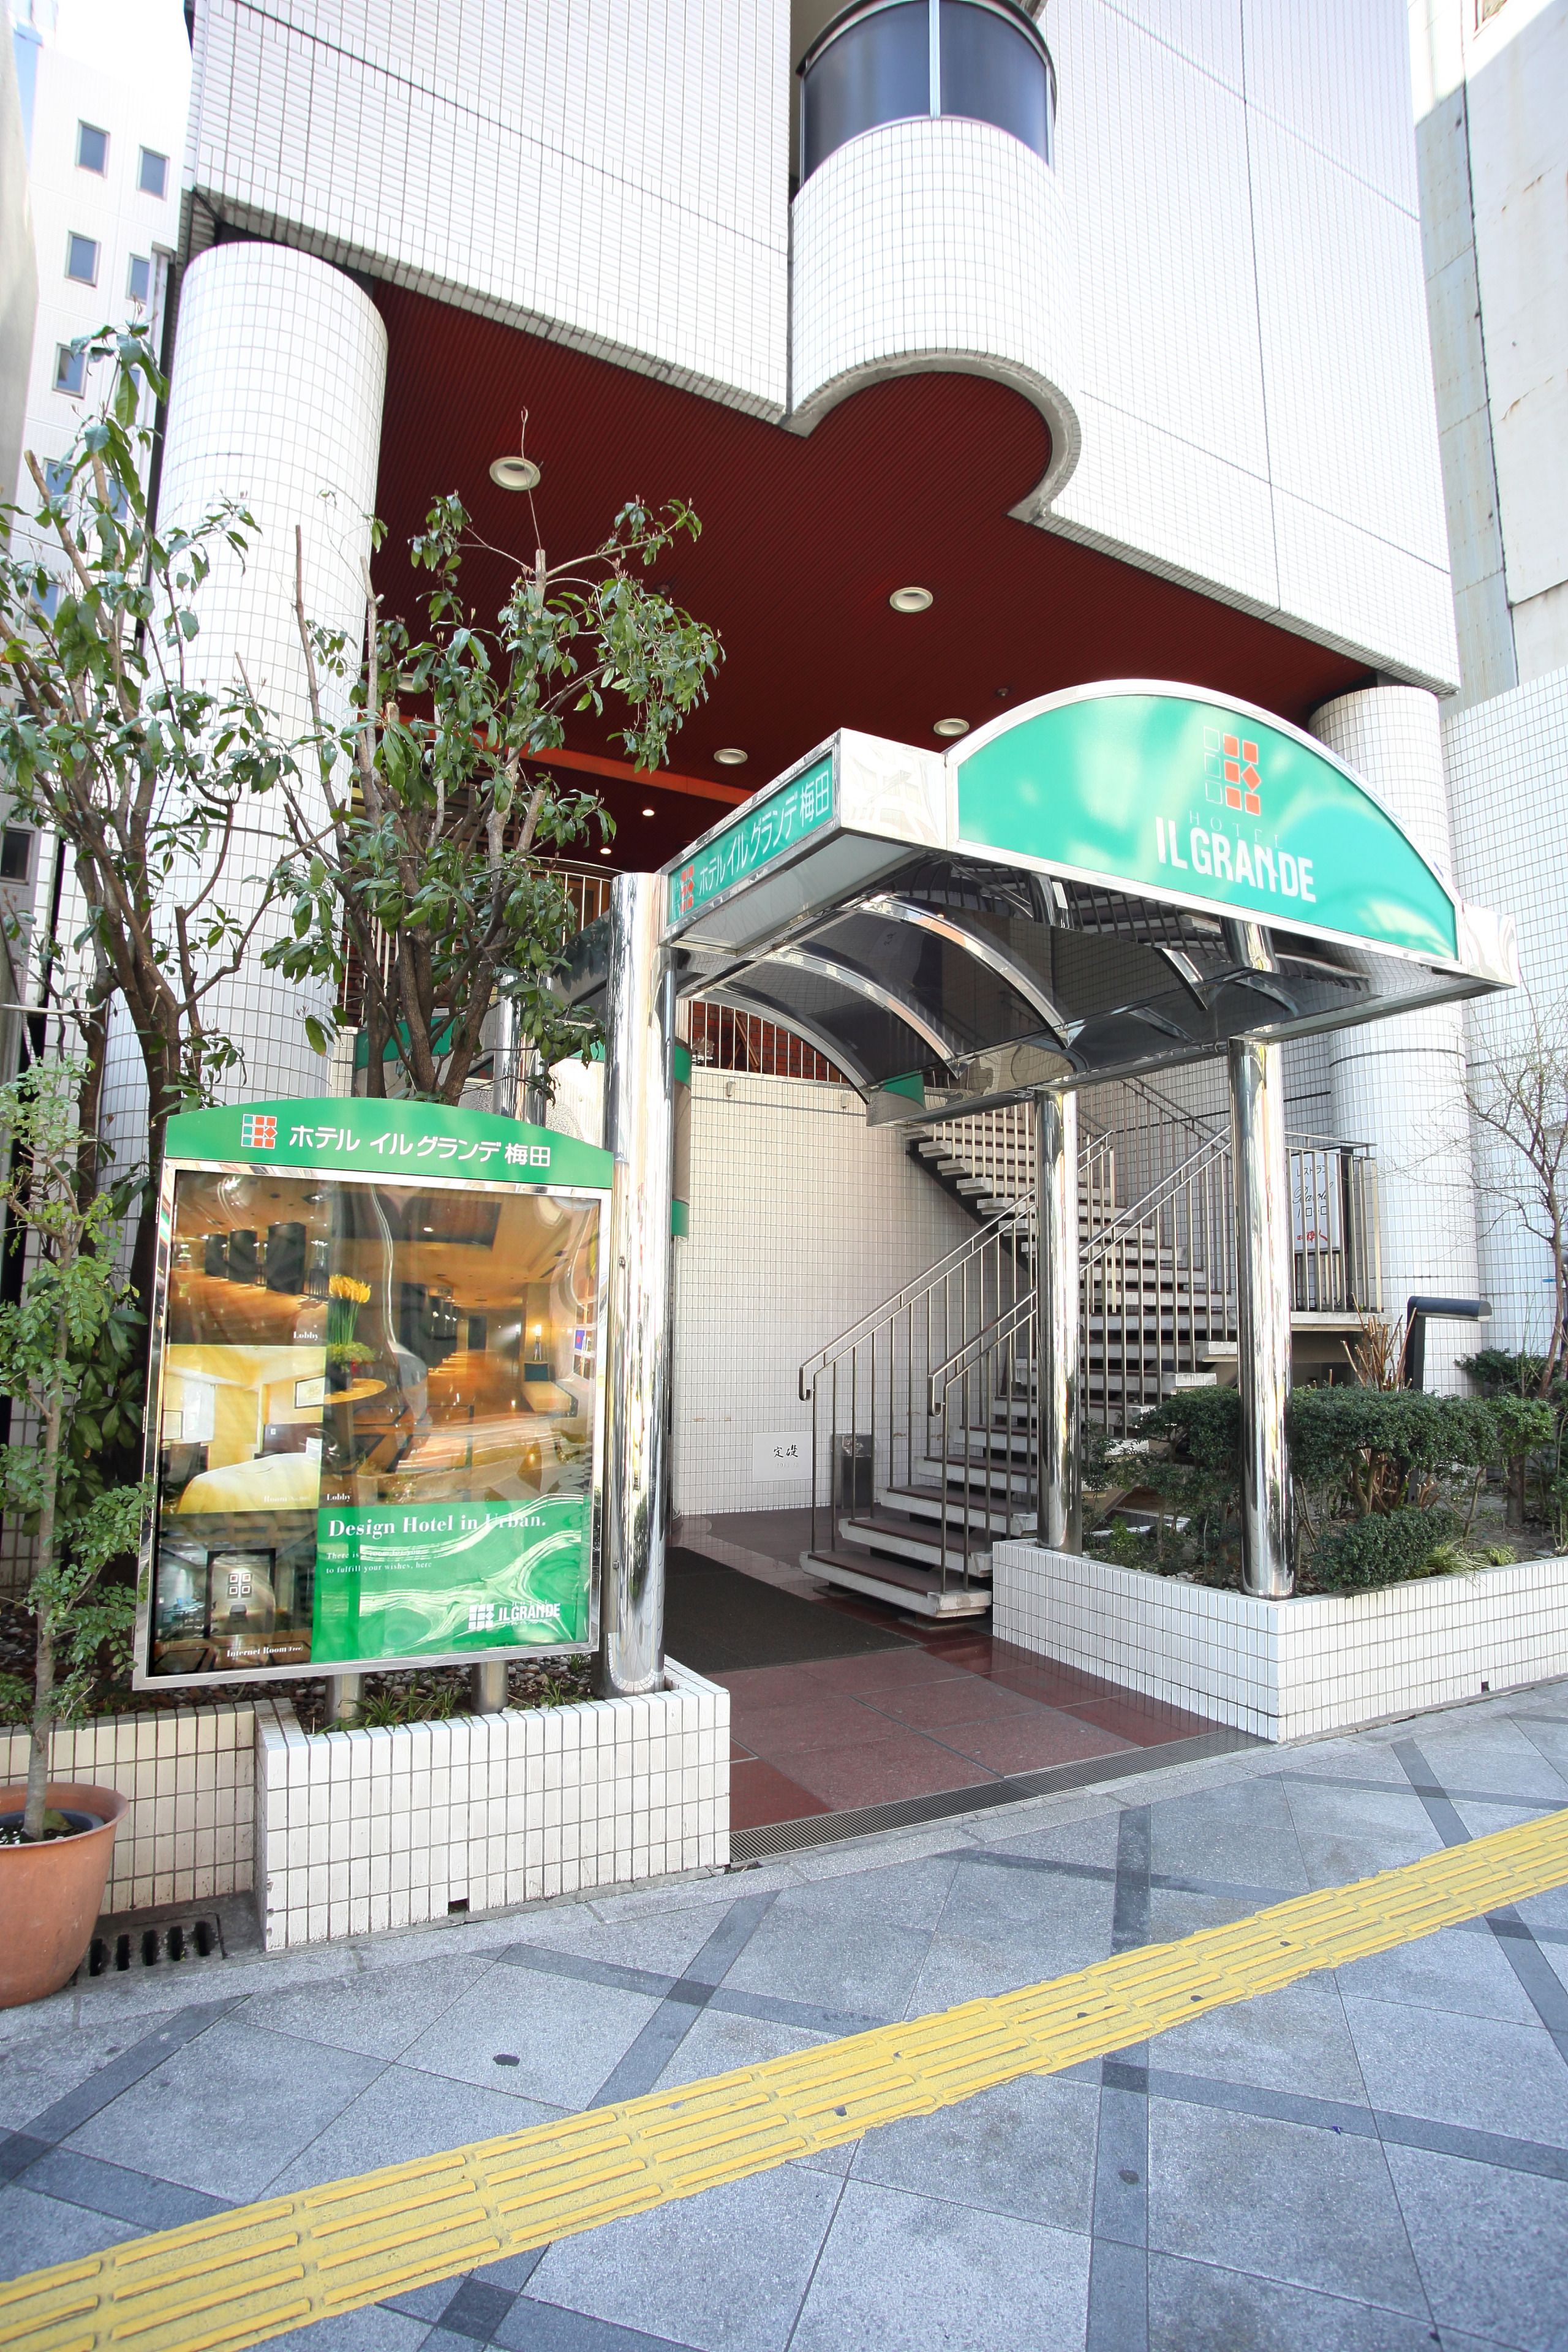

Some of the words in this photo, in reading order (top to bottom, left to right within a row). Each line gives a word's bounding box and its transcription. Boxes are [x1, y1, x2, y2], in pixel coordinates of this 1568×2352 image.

[1189, 810, 1283, 850] HOTEL
[293, 1331, 318, 1341] Lobby
[774, 1444, 798, 1458] 定礎
[326, 1493, 352, 1502] Lobby
[328, 1519, 395, 1539] Design
[402, 1515, 453, 1533] Hotel
[461, 1515, 478, 1530] in
[364, 1564, 382, 1573] your
[227, 1648, 260, 1657] Internet
